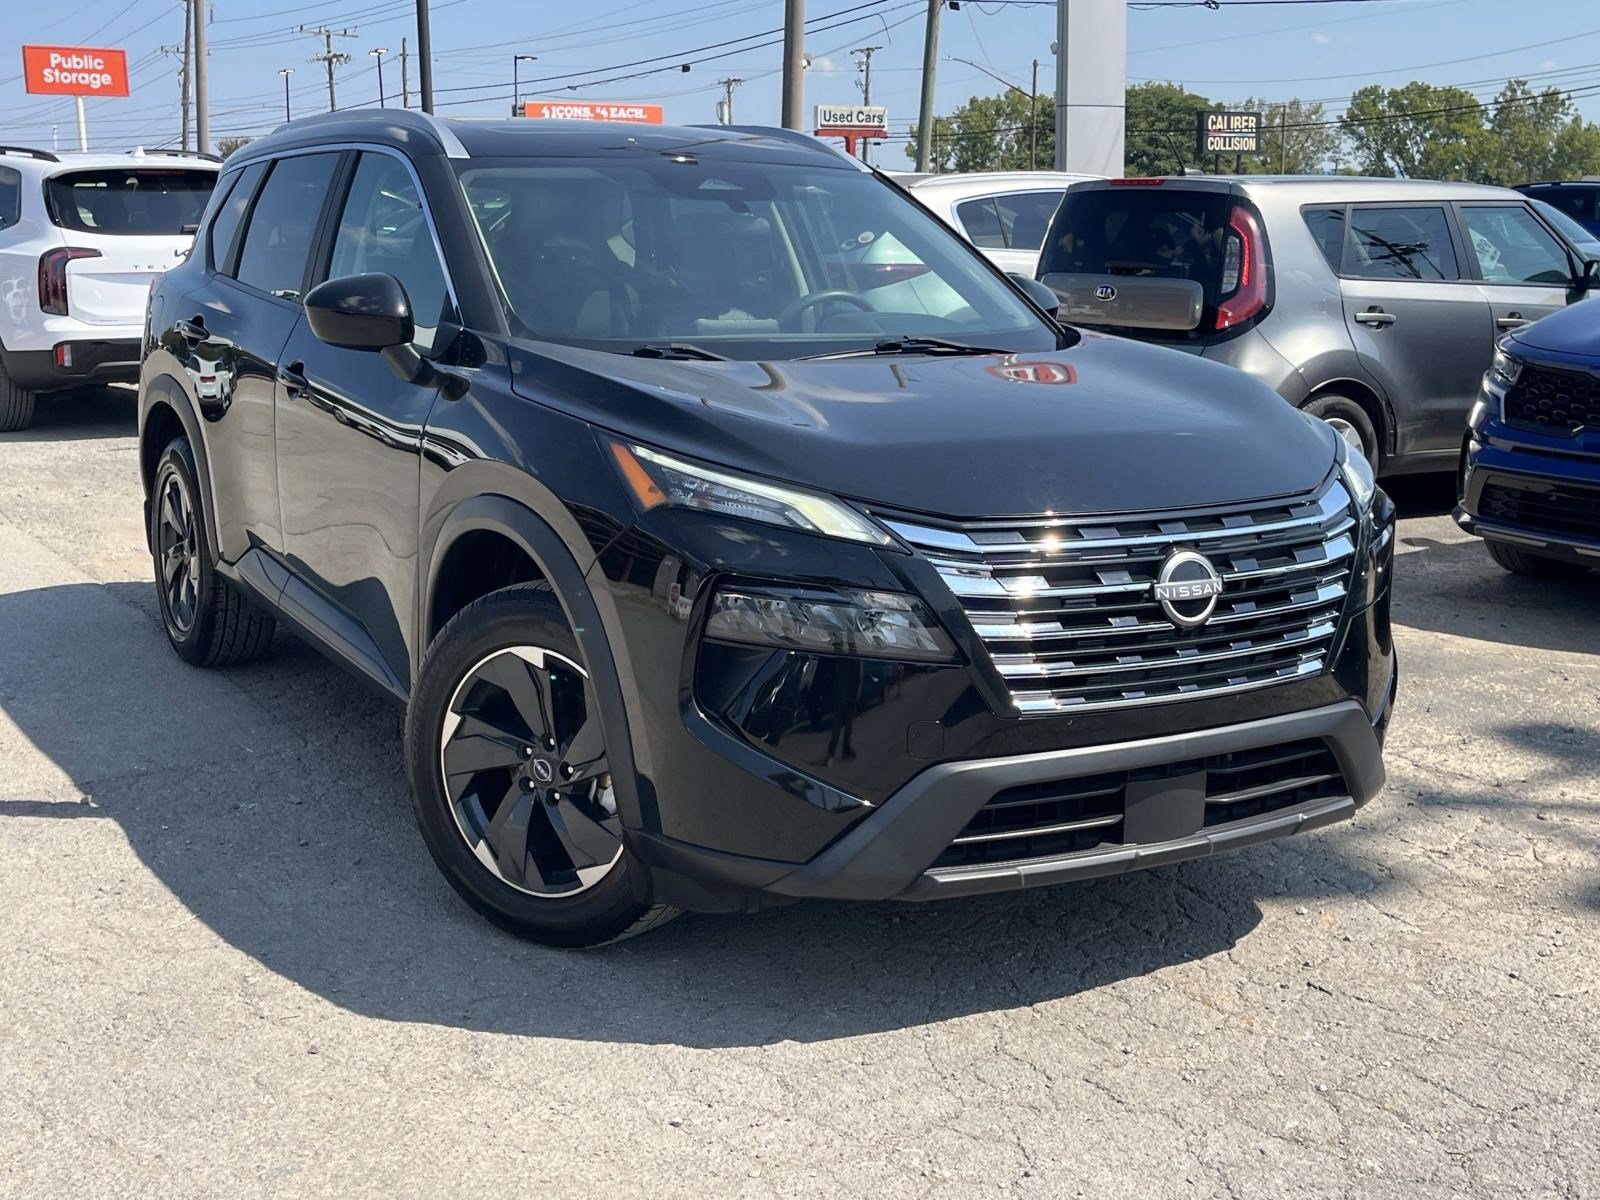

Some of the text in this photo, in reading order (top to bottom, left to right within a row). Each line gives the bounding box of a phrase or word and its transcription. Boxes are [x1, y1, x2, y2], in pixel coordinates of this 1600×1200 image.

[49, 53, 104, 70] Public
[43, 68, 112, 89] Storage
[609, 108, 647, 119] EACH.
[823, 110, 884, 124] Used Cars
[1208, 115, 1256, 132] CALIBER
[1207, 137, 1256, 151] COLLISION
[1096, 287, 1113, 298] KIA
[1156, 582, 1222, 599] NISSAN
